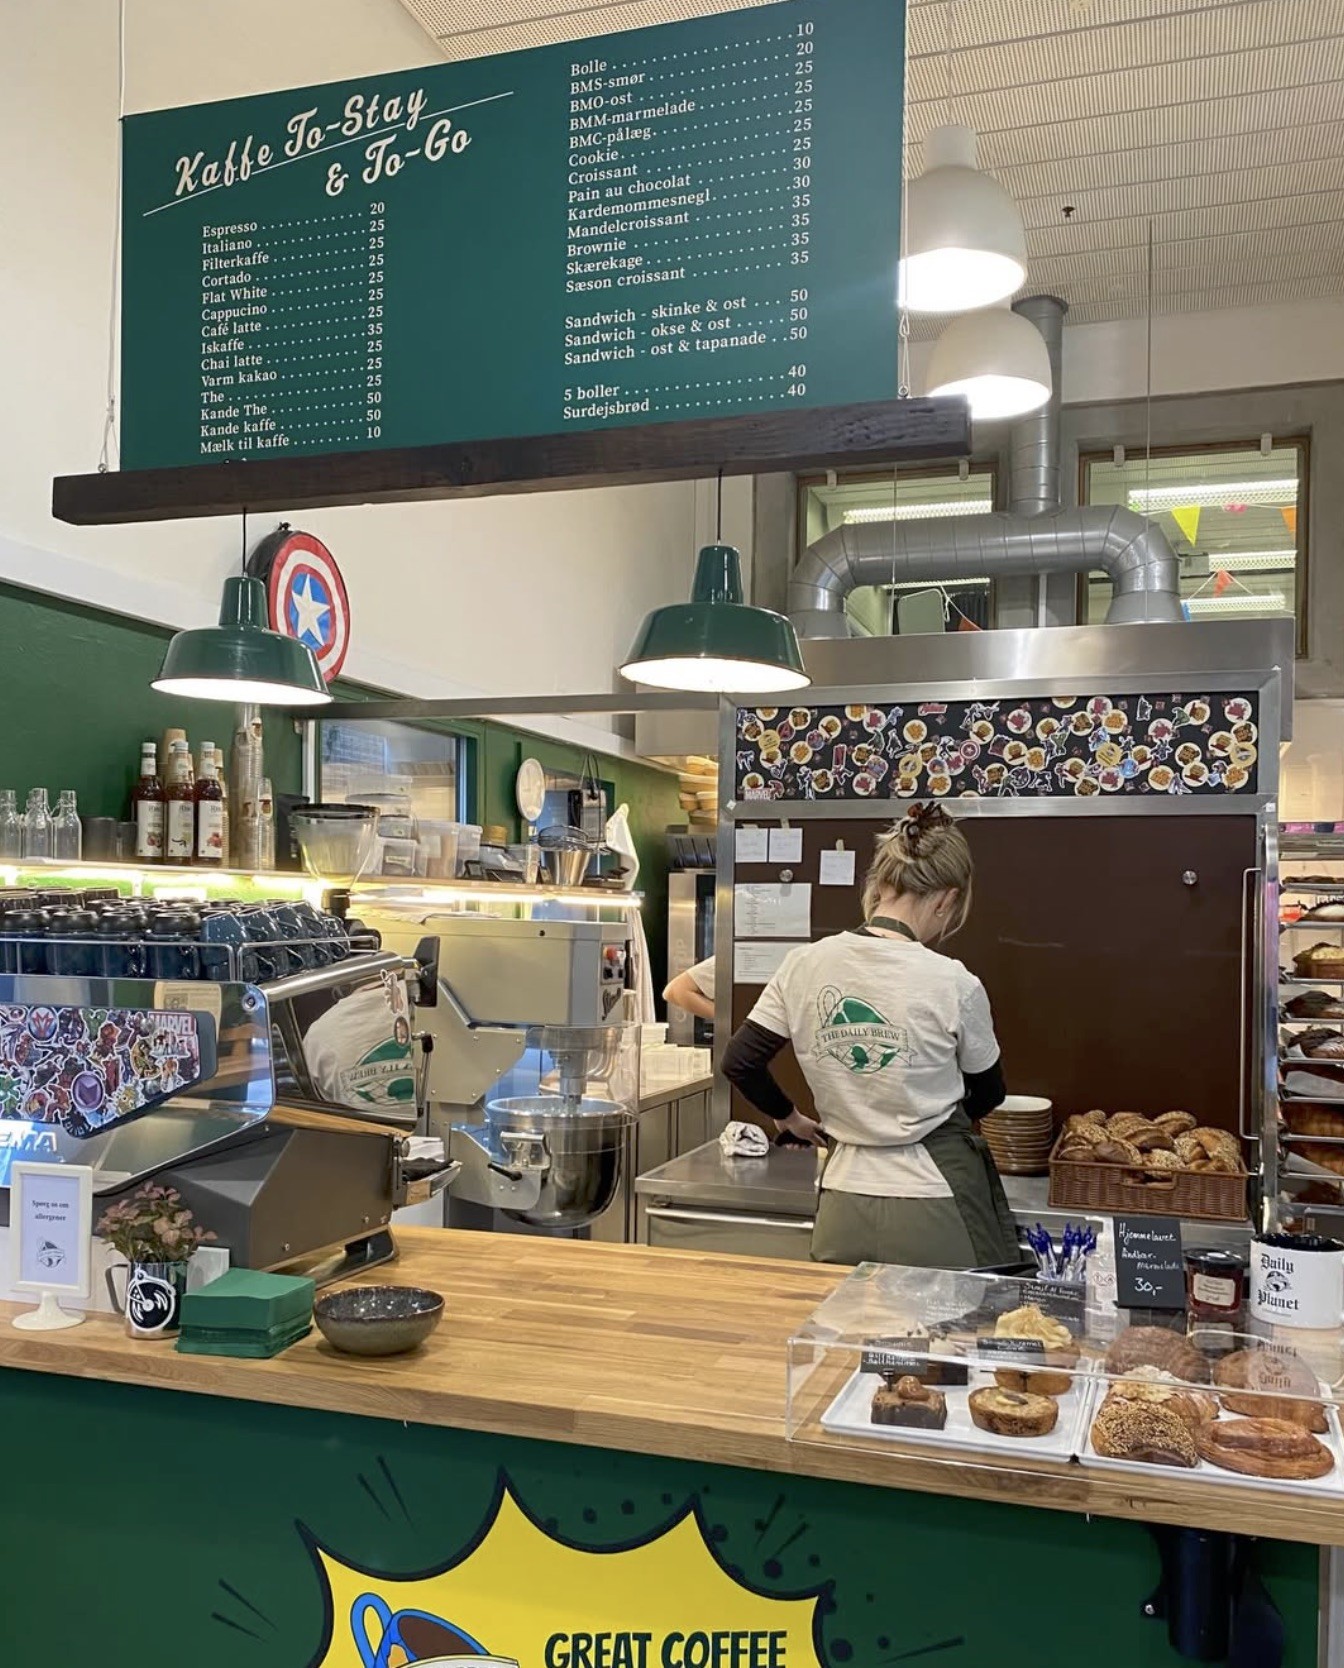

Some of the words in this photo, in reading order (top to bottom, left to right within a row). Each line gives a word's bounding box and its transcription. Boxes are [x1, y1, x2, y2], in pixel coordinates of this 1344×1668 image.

[570, 59, 607, 77] Bolle
[797, 22, 814, 37] 10
[570, 73, 646, 95] BMS-smør
[796, 41, 814, 56] 20
[569, 99, 696, 131] BMM-marmelade
[794, 79, 813, 94] 25
[570, 91, 633, 113] BMO-ost
[795, 60, 813, 75] 25
[175, 135, 273, 196] Kaffe
[284, 88, 427, 157] To-Stay
[568, 148, 619, 167] Cookie
[793, 117, 812, 132] 25
[569, 126, 651, 149] BMC-pålæg
[794, 98, 813, 113] 25
[325, 162, 349, 197] &
[362, 118, 472, 184] To-Go
[568, 164, 638, 185] Croissant
[793, 136, 811, 151] 25
[567, 188, 710, 221] Kardemommesnegl
[792, 175, 810, 189] 30
[568, 187, 600, 204] Pain
[605, 186, 623, 198] au
[628, 174, 691, 194] chocolat
[793, 156, 811, 170] 30
[202, 221, 258, 240] Espresso
[370, 201, 385, 215] 20
[567, 211, 689, 239] Mandelcroissant
[792, 194, 810, 208] 35
[567, 237, 627, 257] Brownie
[791, 212, 810, 227] 35
[202, 239, 252, 255] Italiano
[369, 219, 385, 232] 25
[202, 251, 270, 271] Filterkaffe
[369, 236, 384, 250] 25
[566, 256, 643, 275] Skærekage
[791, 231, 809, 246] 35
[201, 270, 252, 288] Cortado
[368, 253, 384, 267] 25
[202, 291, 226, 305] Flat
[229, 285, 268, 301] White
[368, 270, 384, 284] 25
[565, 278, 612, 293] Sæson
[617, 267, 685, 287] croissant
[790, 250, 809, 265] 35
[201, 303, 268, 323] Cappucino
[368, 288, 384, 301] 25
[201, 322, 229, 338] Café
[233, 321, 262, 335] latte
[368, 305, 384, 318] 25
[565, 308, 636, 330] Sandwich
[651, 301, 701, 319] skinke
[705, 299, 718, 312] &
[723, 296, 746, 310] ost
[790, 288, 808, 302] 50
[201, 337, 245, 355] Iskaffe
[367, 322, 383, 336] 35
[564, 326, 636, 347] Sandwich
[651, 323, 686, 337] okse
[690, 319, 702, 333] &
[707, 316, 731, 331] ost
[789, 307, 808, 322] 50
[564, 345, 635, 365] Sandwich
[650, 342, 673, 356] ost
[678, 339, 690, 353] &
[695, 330, 767, 353] tapanade
[789, 326, 808, 340] 50
[201, 355, 230, 371] Chai
[234, 354, 263, 368] latte
[367, 339, 383, 353] 25
[201, 375, 234, 387] Varm
[238, 369, 277, 384] kakao
[367, 357, 383, 370] 25
[200, 390, 225, 404] The
[366, 374, 382, 387] 25
[563, 388, 572, 401] 5
[577, 384, 620, 400] boller
[788, 364, 806, 378] 40
[563, 397, 650, 420] Surdejsbrød
[787, 383, 806, 397] 40
[200, 405, 240, 421] Kande
[243, 403, 268, 416] The
[366, 391, 382, 405] 50
[200, 422, 240, 437] Kande
[243, 417, 276, 433] kaffe
[366, 408, 382, 422] 50
[200, 438, 235, 454] Mælk
[238, 436, 253, 450] til
[256, 433, 290, 449] kaffe
[367, 425, 381, 439] 10
[821, 1031, 839, 1042] THE
[841, 1027, 869, 1037] DAILY
[871, 1028, 900, 1041] BREW
[1260, 1253, 1294, 1274] Daily
[1134, 1276, 1163, 1296] 30,-
[1258, 1289, 1298, 1310] Planet
[545, 1632, 652, 1668] GREAT
[661, 1630, 787, 1668] COFFEE
